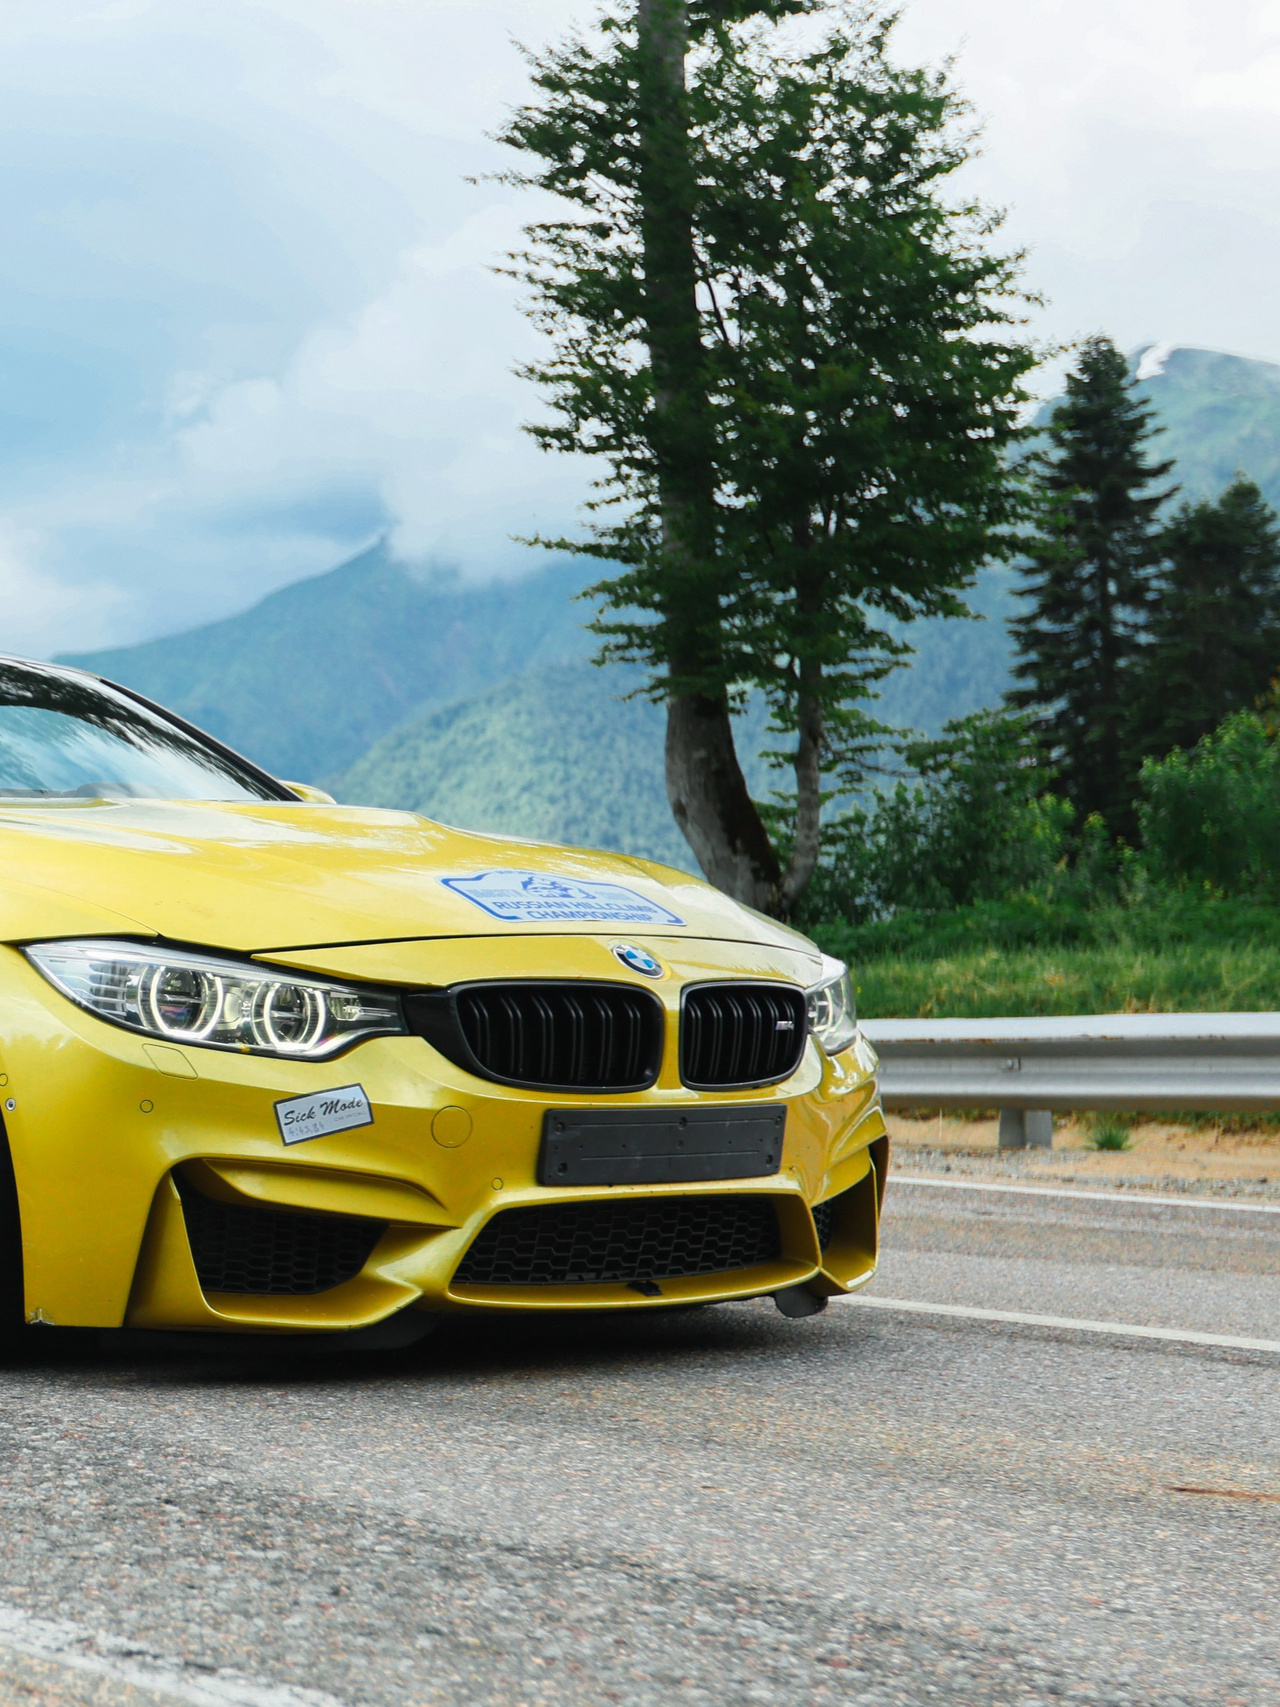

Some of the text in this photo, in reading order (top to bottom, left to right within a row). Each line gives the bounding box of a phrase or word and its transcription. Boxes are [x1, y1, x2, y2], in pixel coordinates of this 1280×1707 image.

[491, 901, 658, 913] RUSSIAN HILLCLIMB
[526, 910, 654, 921] CHAMPIONSHIP
[284, 1106, 317, 1126] Sick
[320, 1097, 364, 1116] Mode
